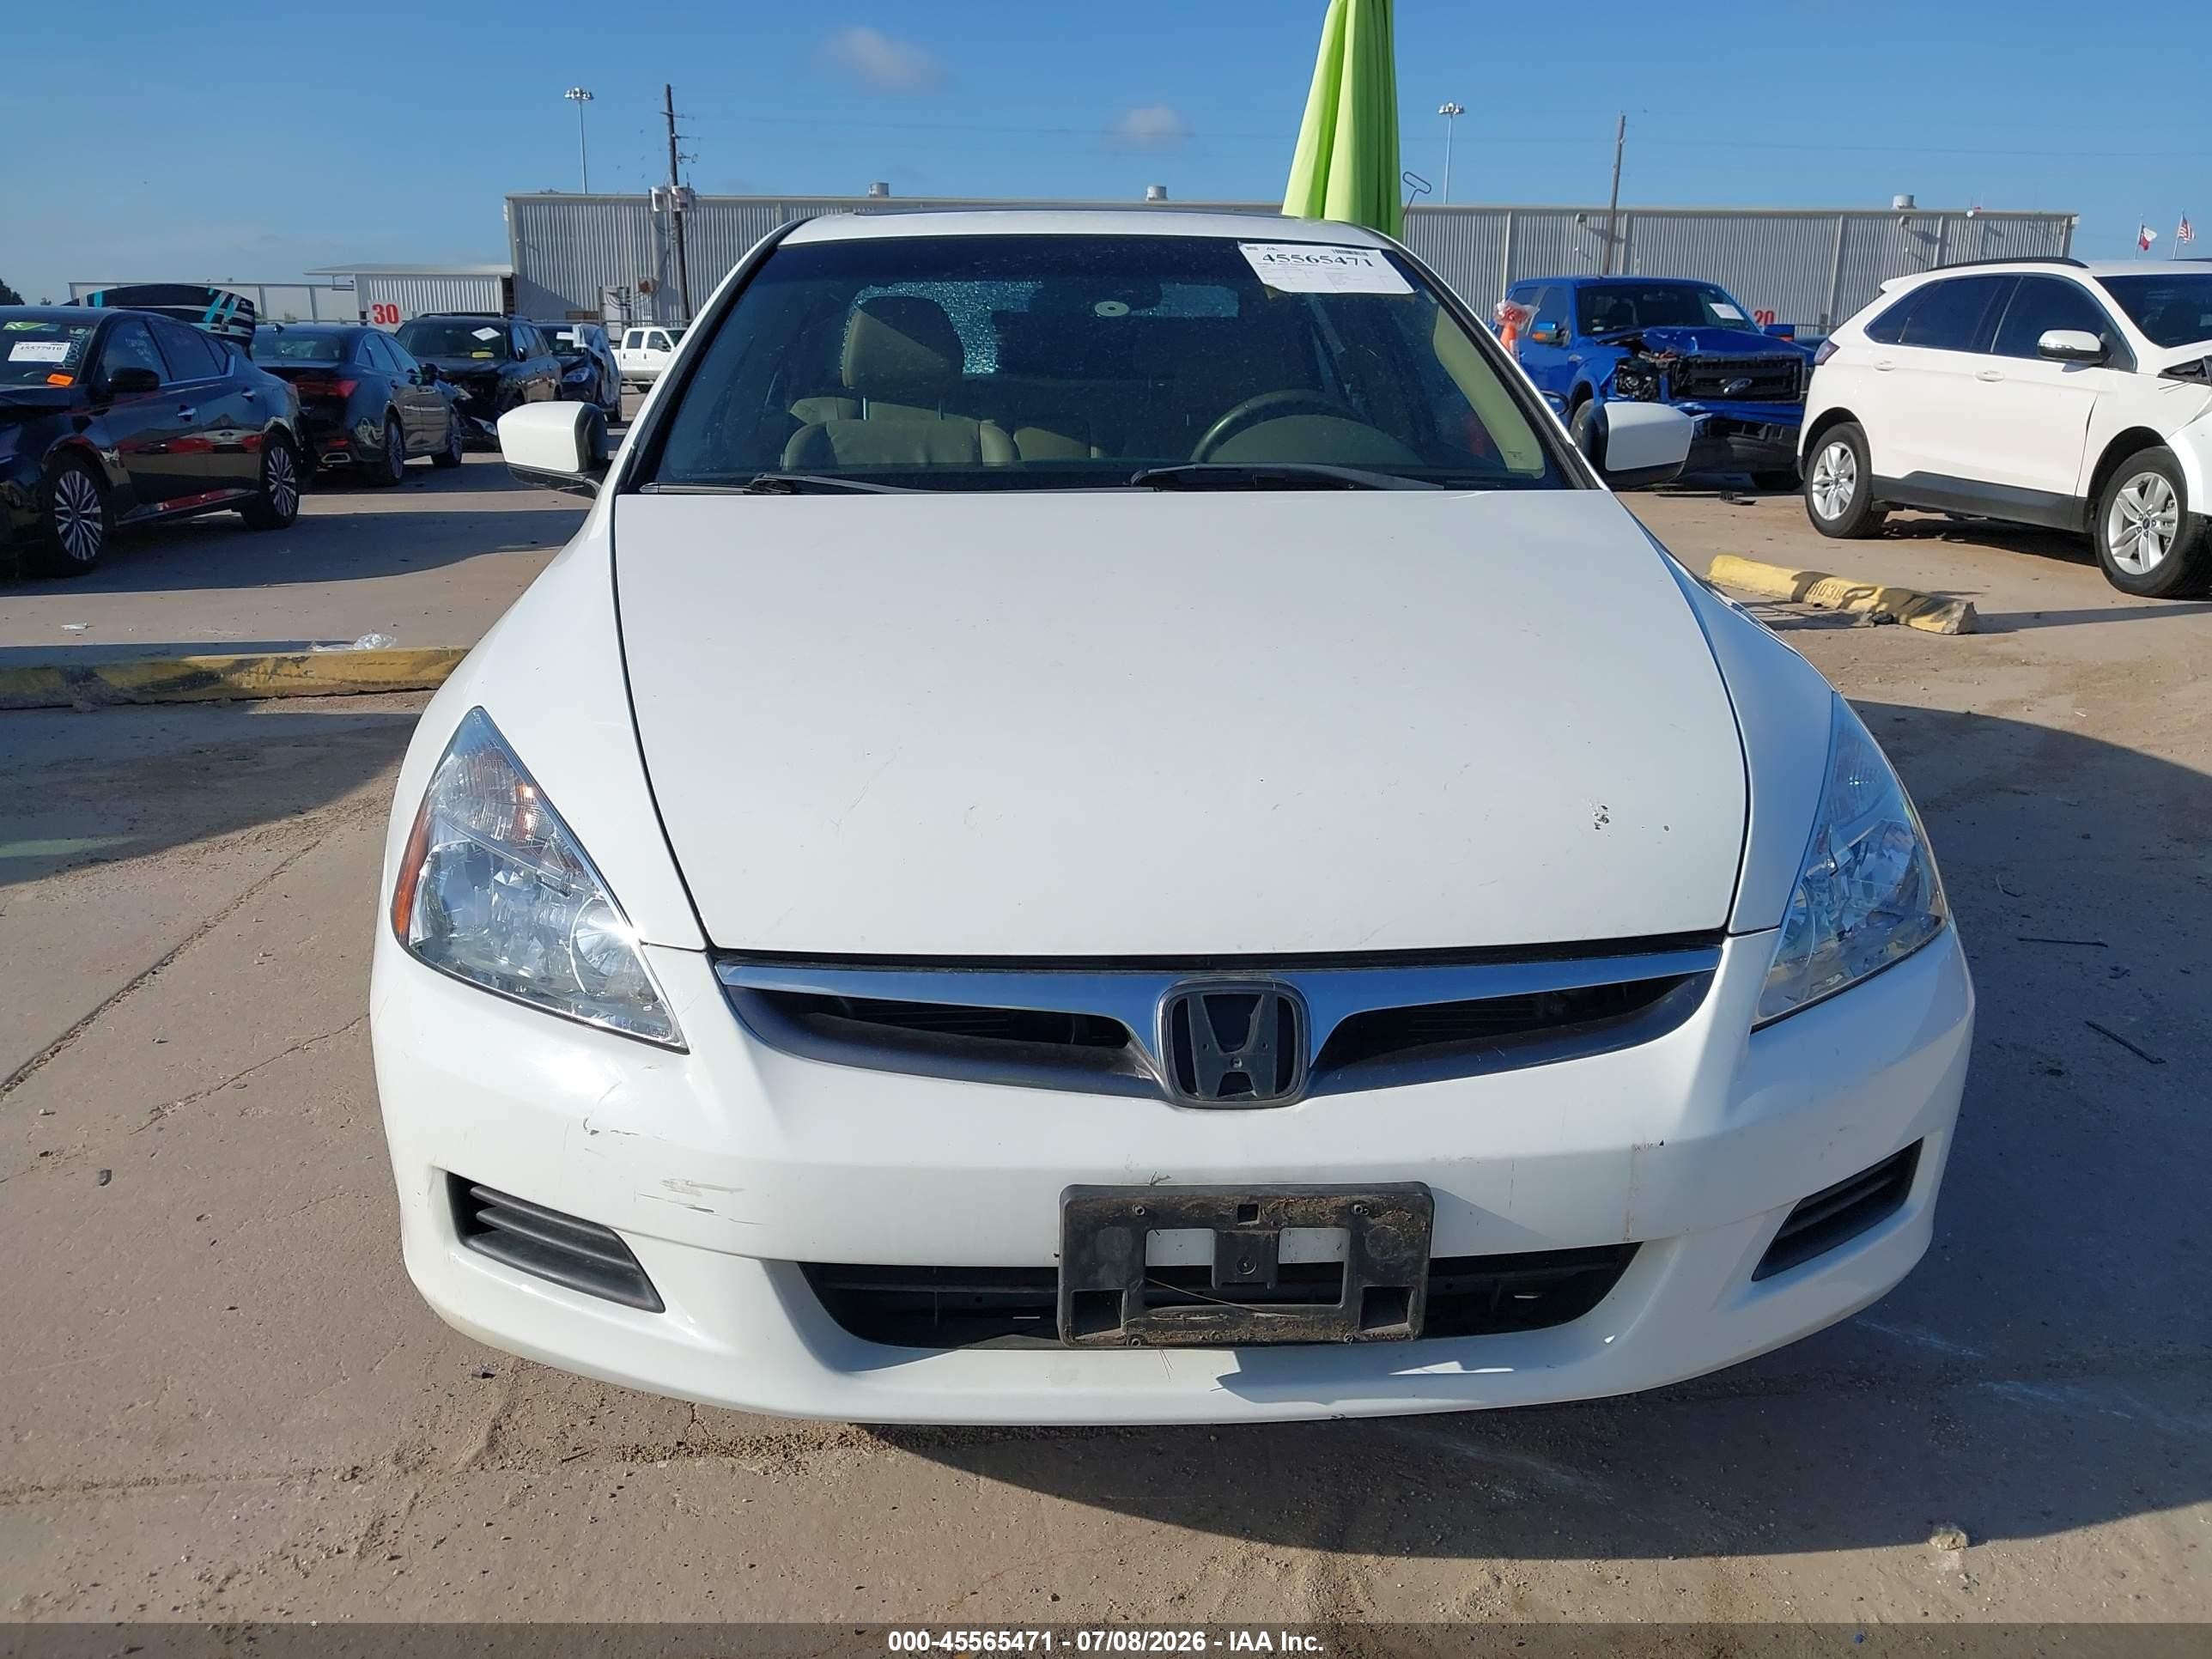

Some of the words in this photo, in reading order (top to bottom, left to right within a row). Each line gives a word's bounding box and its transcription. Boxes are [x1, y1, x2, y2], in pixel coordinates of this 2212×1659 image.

[1262, 253, 1374, 268] 45565471
[372, 303, 399, 325] 30
[1754, 310, 1775, 325] 20
